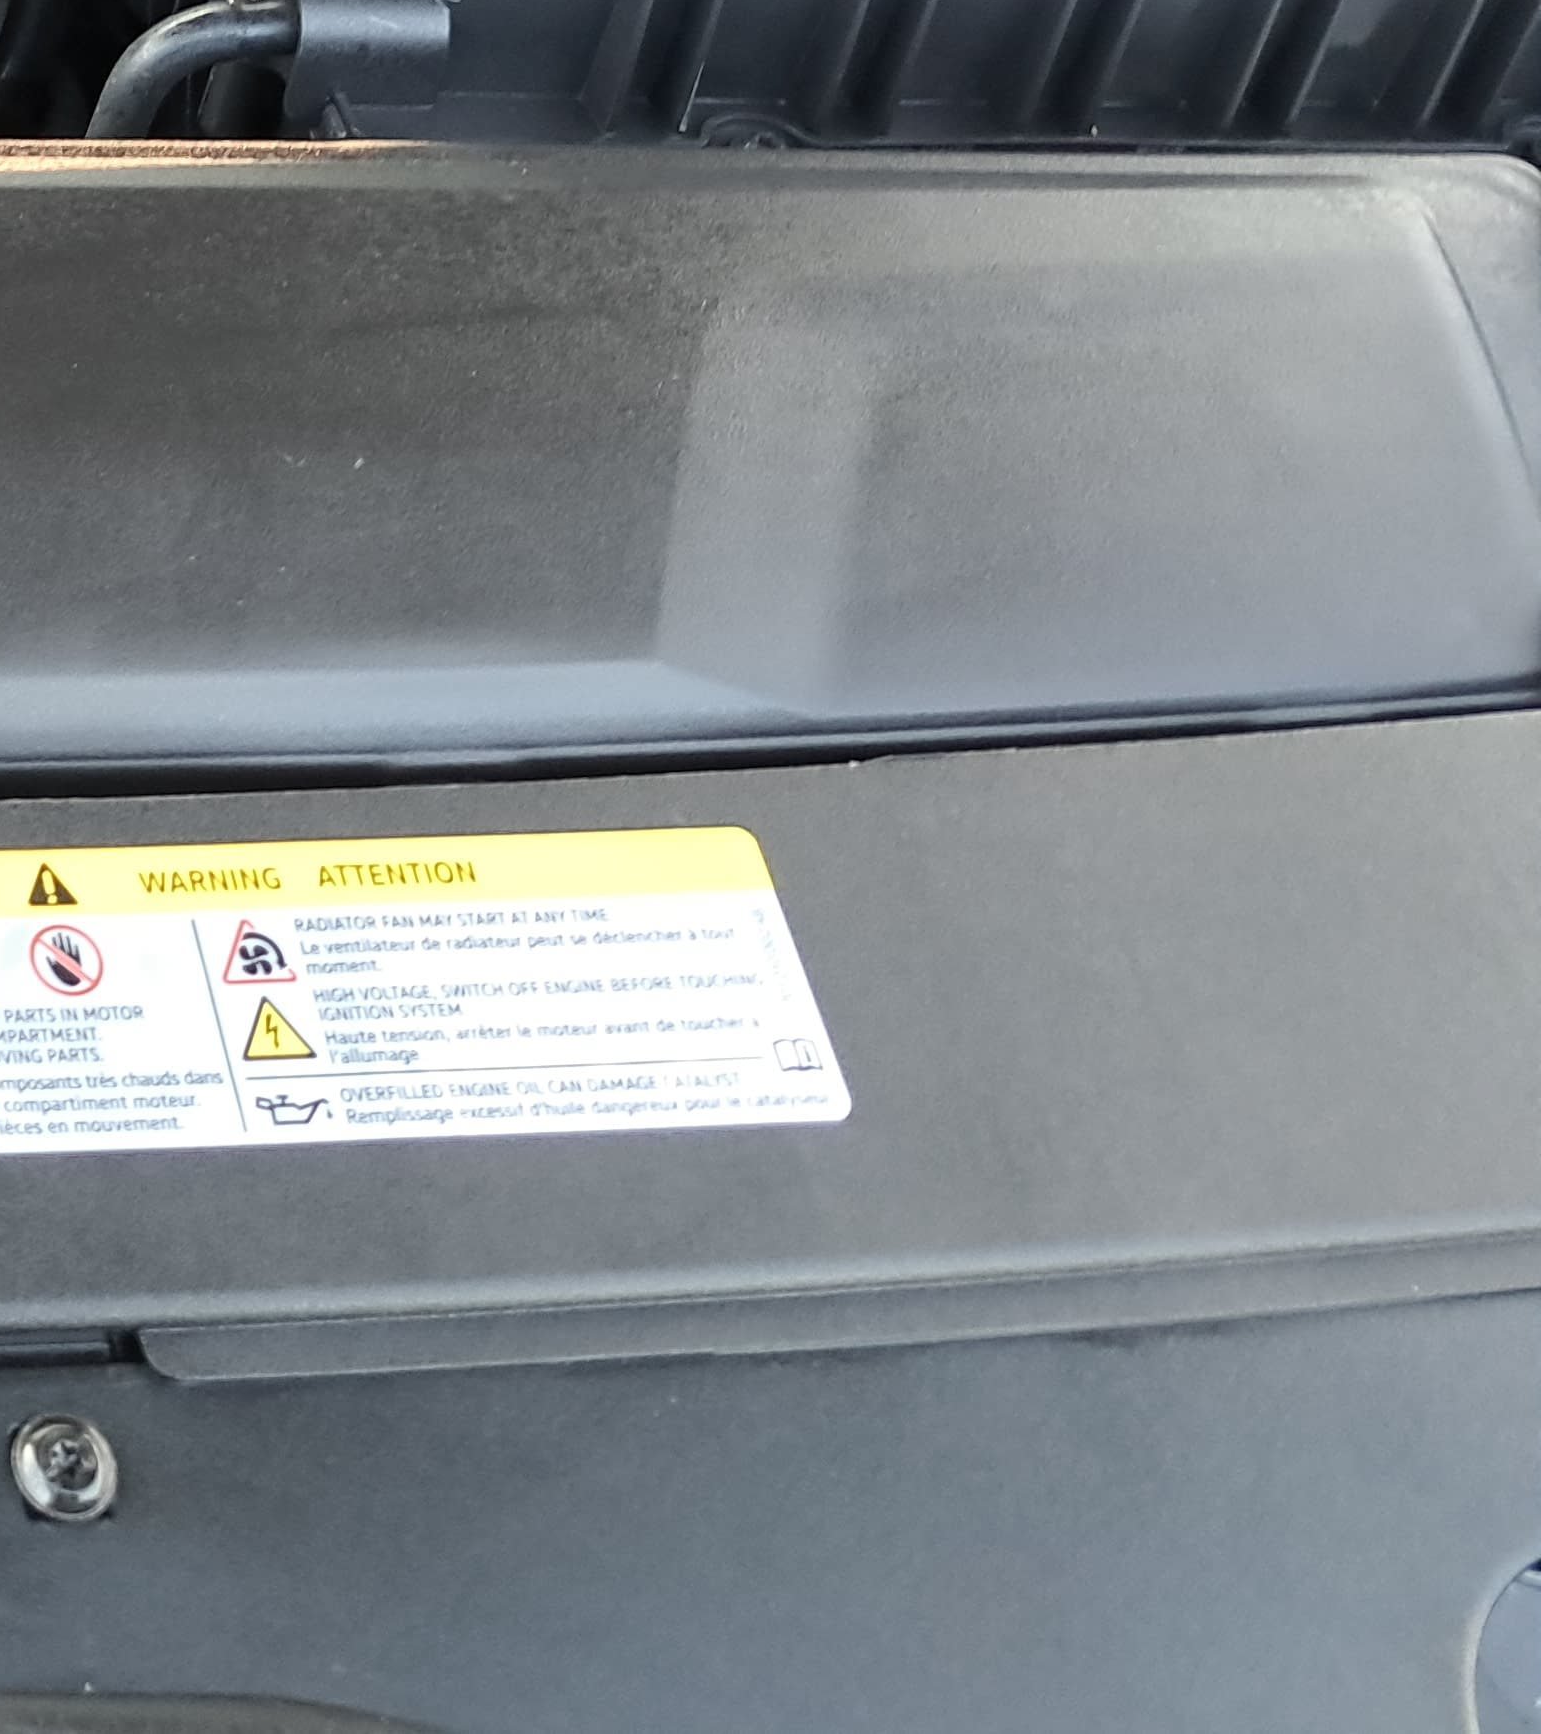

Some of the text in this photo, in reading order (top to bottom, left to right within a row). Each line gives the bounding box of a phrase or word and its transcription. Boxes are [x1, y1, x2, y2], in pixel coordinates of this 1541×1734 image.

[138, 867, 281, 893] WARNING
[319, 861, 476, 887] ATTENTION
[3, 1008, 57, 1023] PARTS
[59, 1008, 79, 1021] IN
[82, 1005, 144, 1021] MOTOR
[84, 1075, 118, 1088] très
[121, 1071, 181, 1088] chauds
[183, 1071, 224, 1085] dans
[3, 1096, 128, 1115] compartiment
[47, 1121, 69, 1134] en
